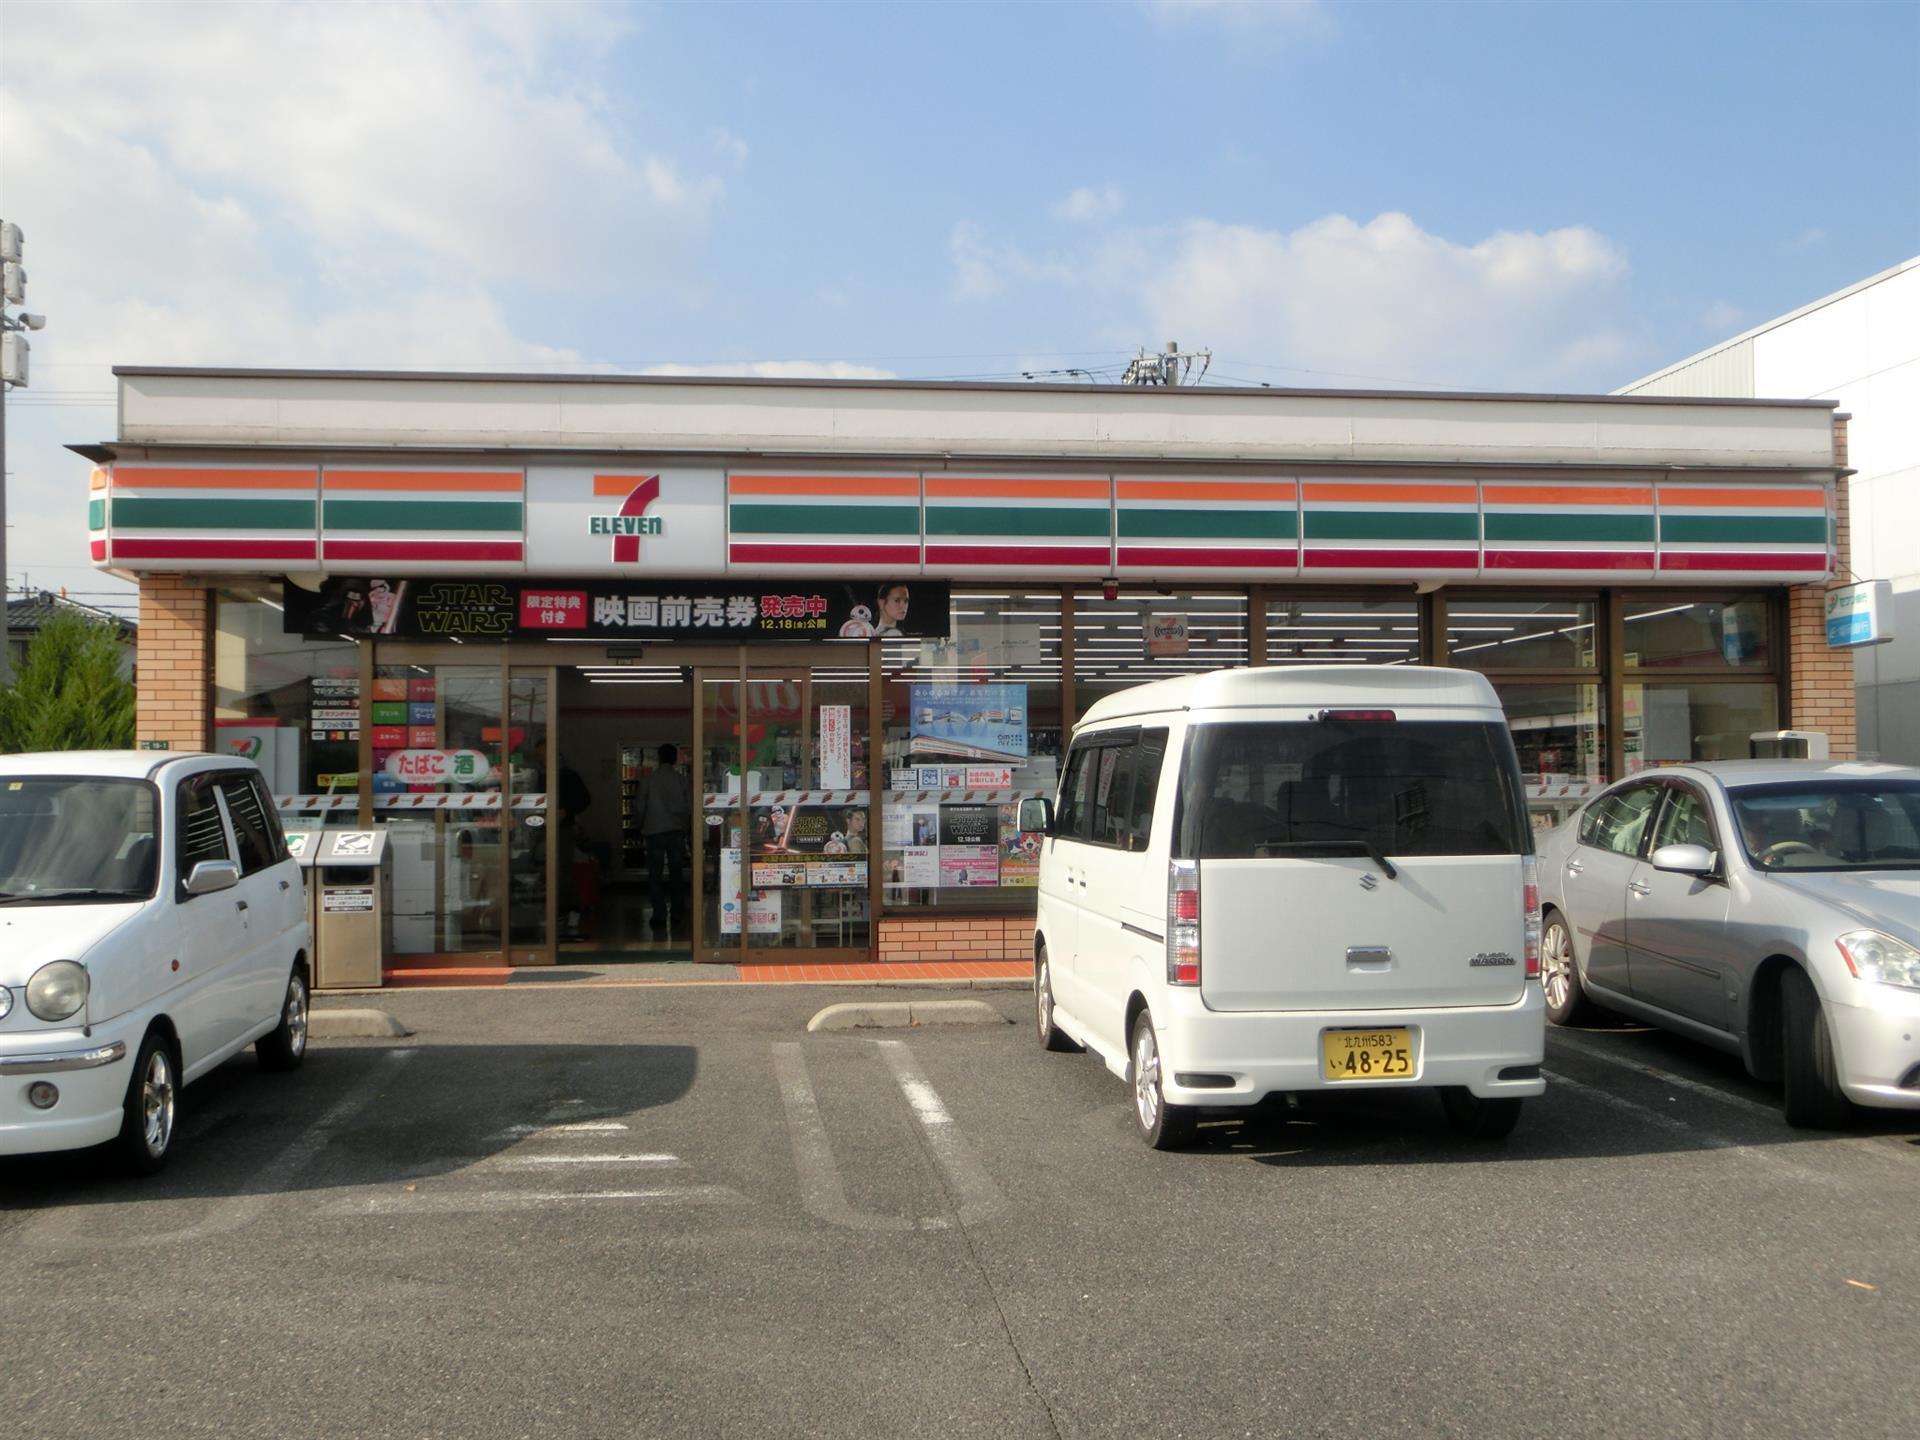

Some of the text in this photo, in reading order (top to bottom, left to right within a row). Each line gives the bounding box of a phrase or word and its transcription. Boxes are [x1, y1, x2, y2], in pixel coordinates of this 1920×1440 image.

[593, 475, 660, 563] 7
[417, 584, 513, 605] STAR
[526, 596, 581, 609] 限定特典
[593, 595, 757, 627] 映画前売券
[760, 595, 827, 618] 発売中
[417, 611, 513, 633] WARS
[540, 611, 567, 624] 付き
[398, 755, 445, 774] たばこ
[454, 755, 474, 774] 酒
[950, 824, 988, 834] WARS
[1329, 1049, 1408, 1074] い 48-25
